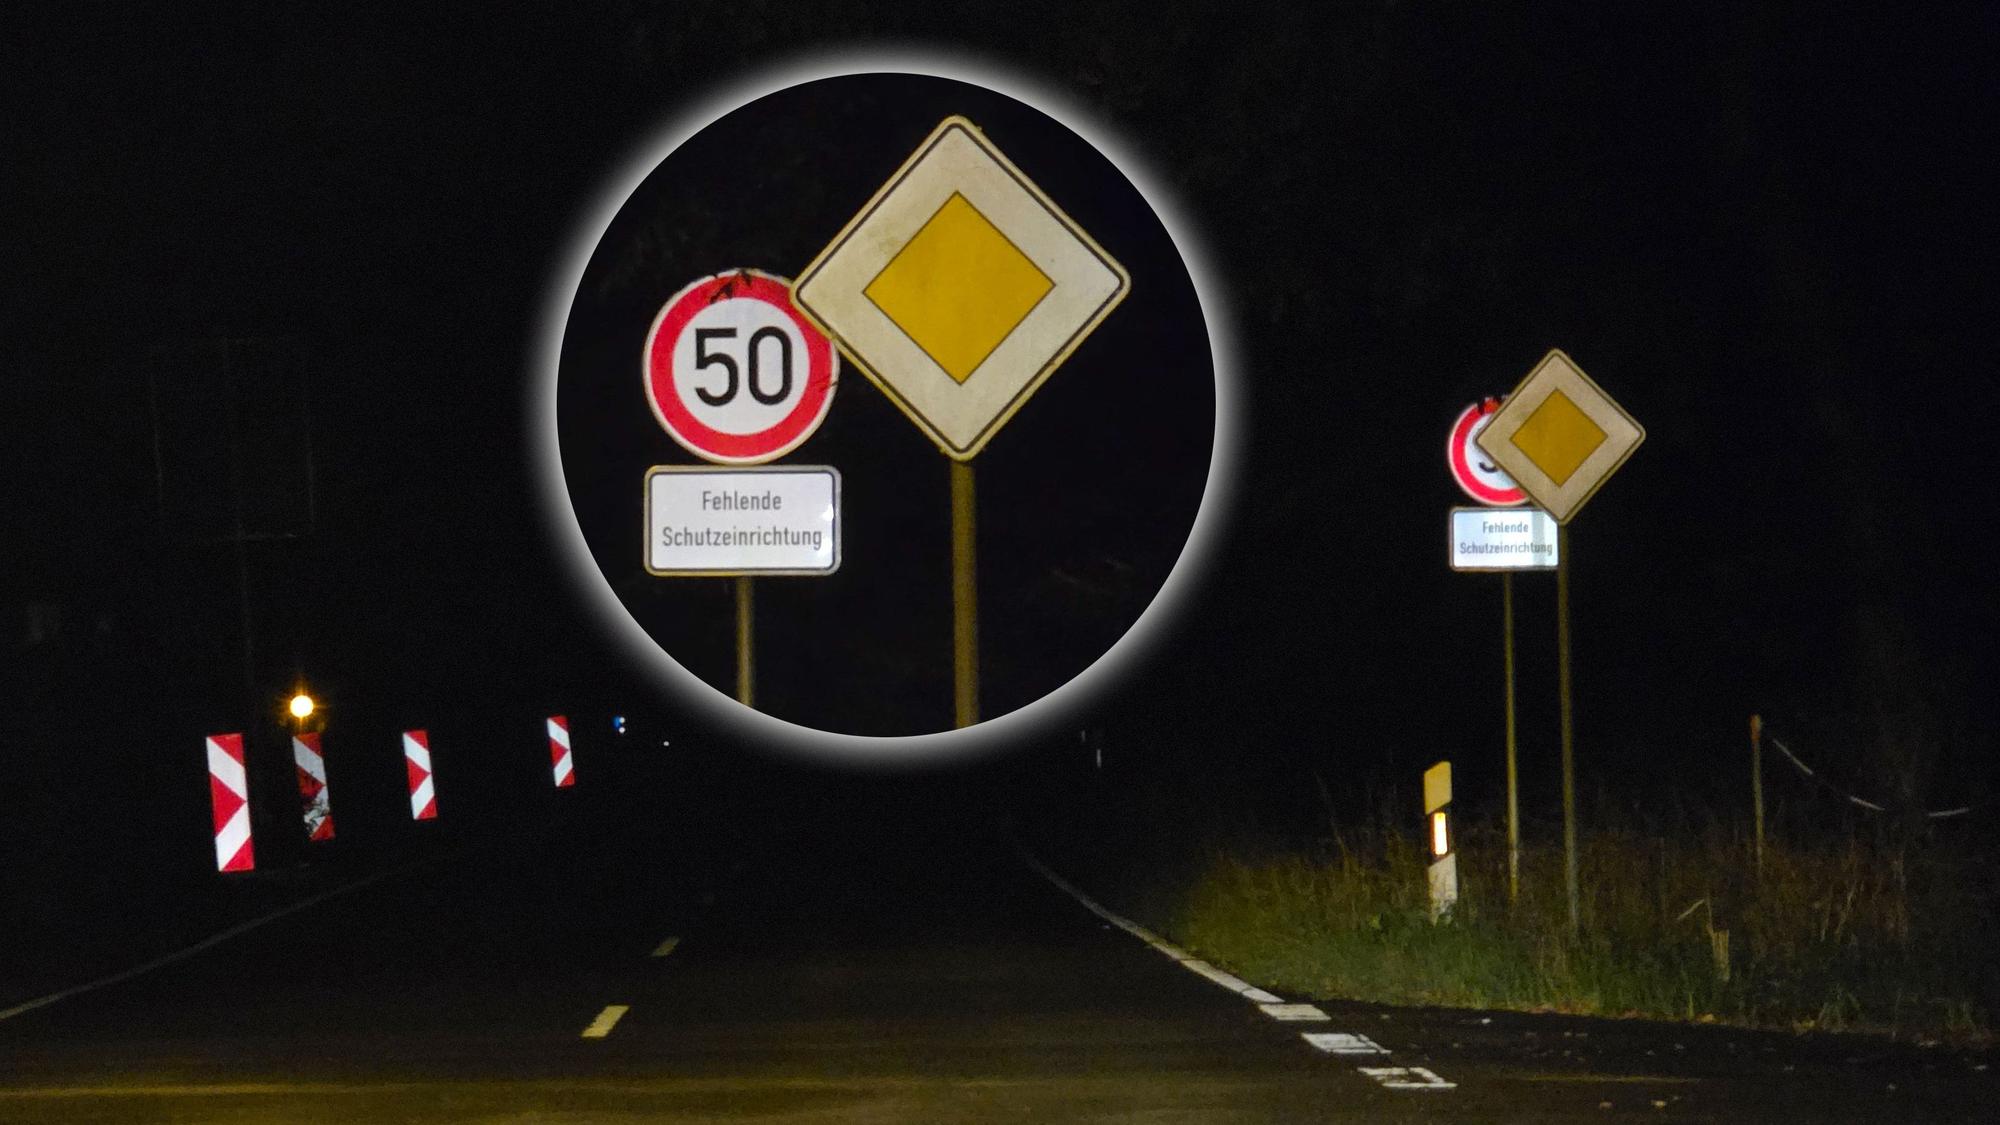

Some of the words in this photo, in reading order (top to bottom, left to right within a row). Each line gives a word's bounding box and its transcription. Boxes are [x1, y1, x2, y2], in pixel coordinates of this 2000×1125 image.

[695, 326, 792, 407] 50
[702, 491, 782, 511] Fehlende
[1482, 521, 1529, 533] Fehlende
[662, 526, 822, 550] Schutzeinrichtung
[1459, 542, 1553, 555] Schutzeinrichtung
